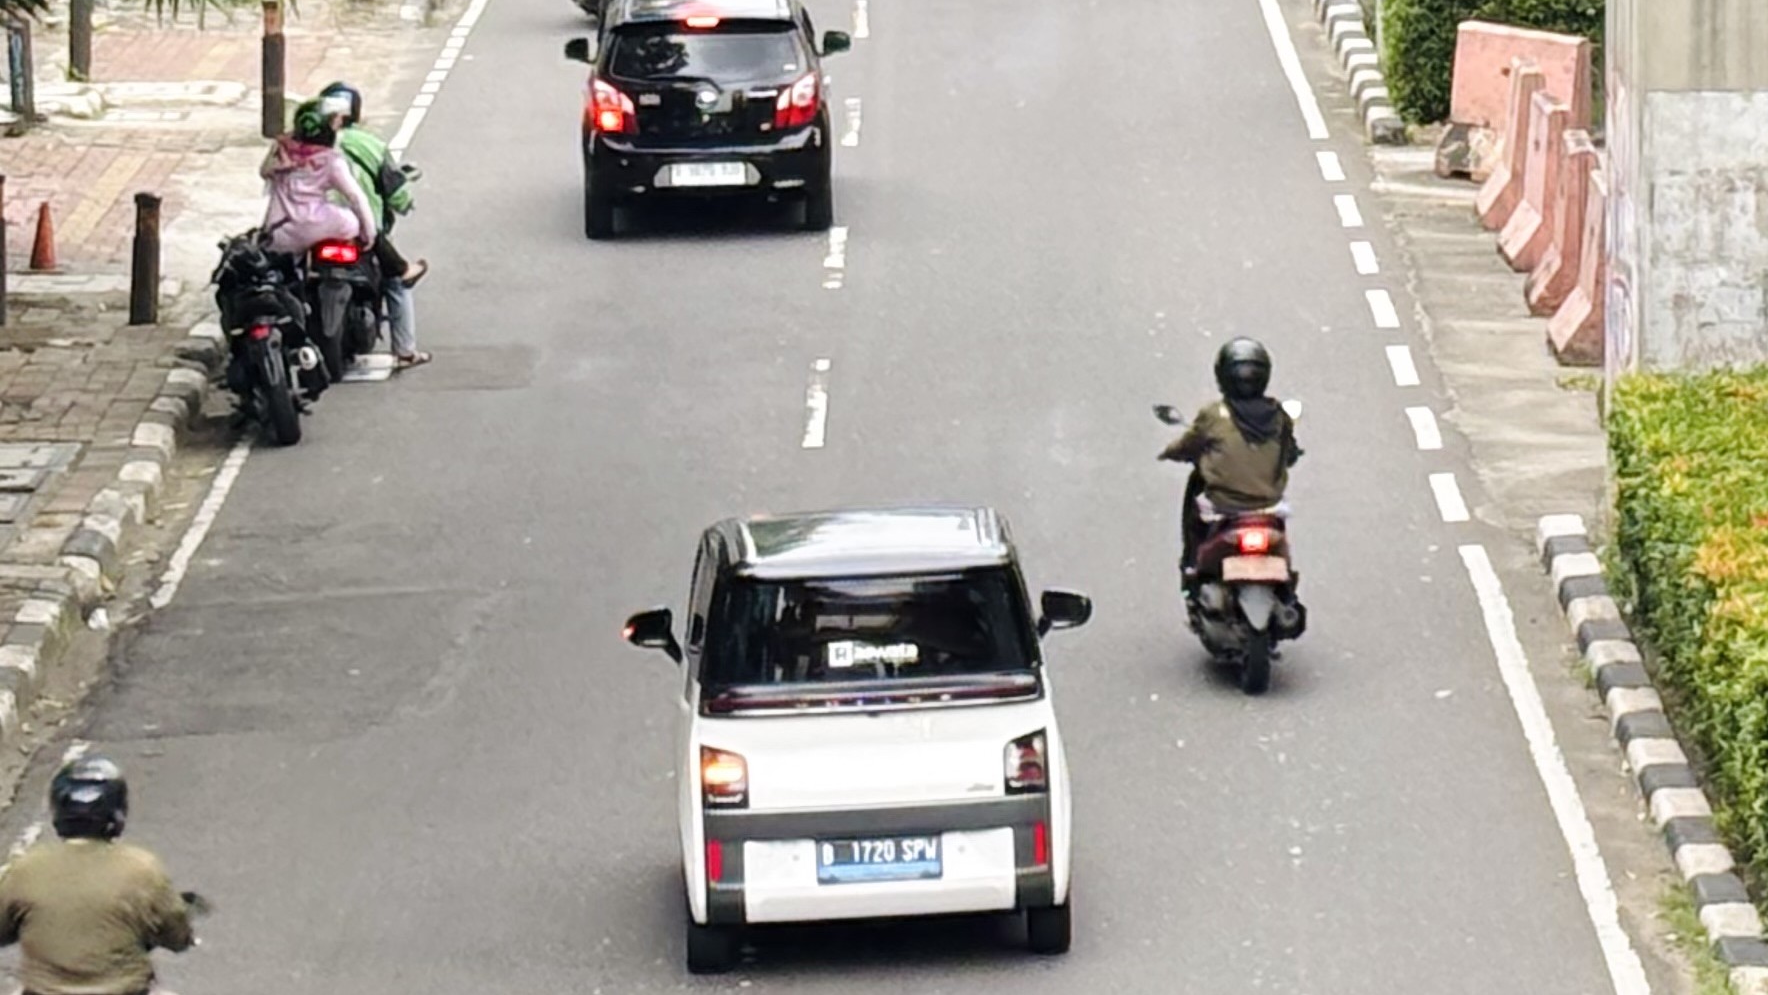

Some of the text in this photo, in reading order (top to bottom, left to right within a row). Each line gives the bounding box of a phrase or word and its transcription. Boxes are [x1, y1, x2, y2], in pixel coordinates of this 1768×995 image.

[822, 836, 938, 866] B 1720 SPW
